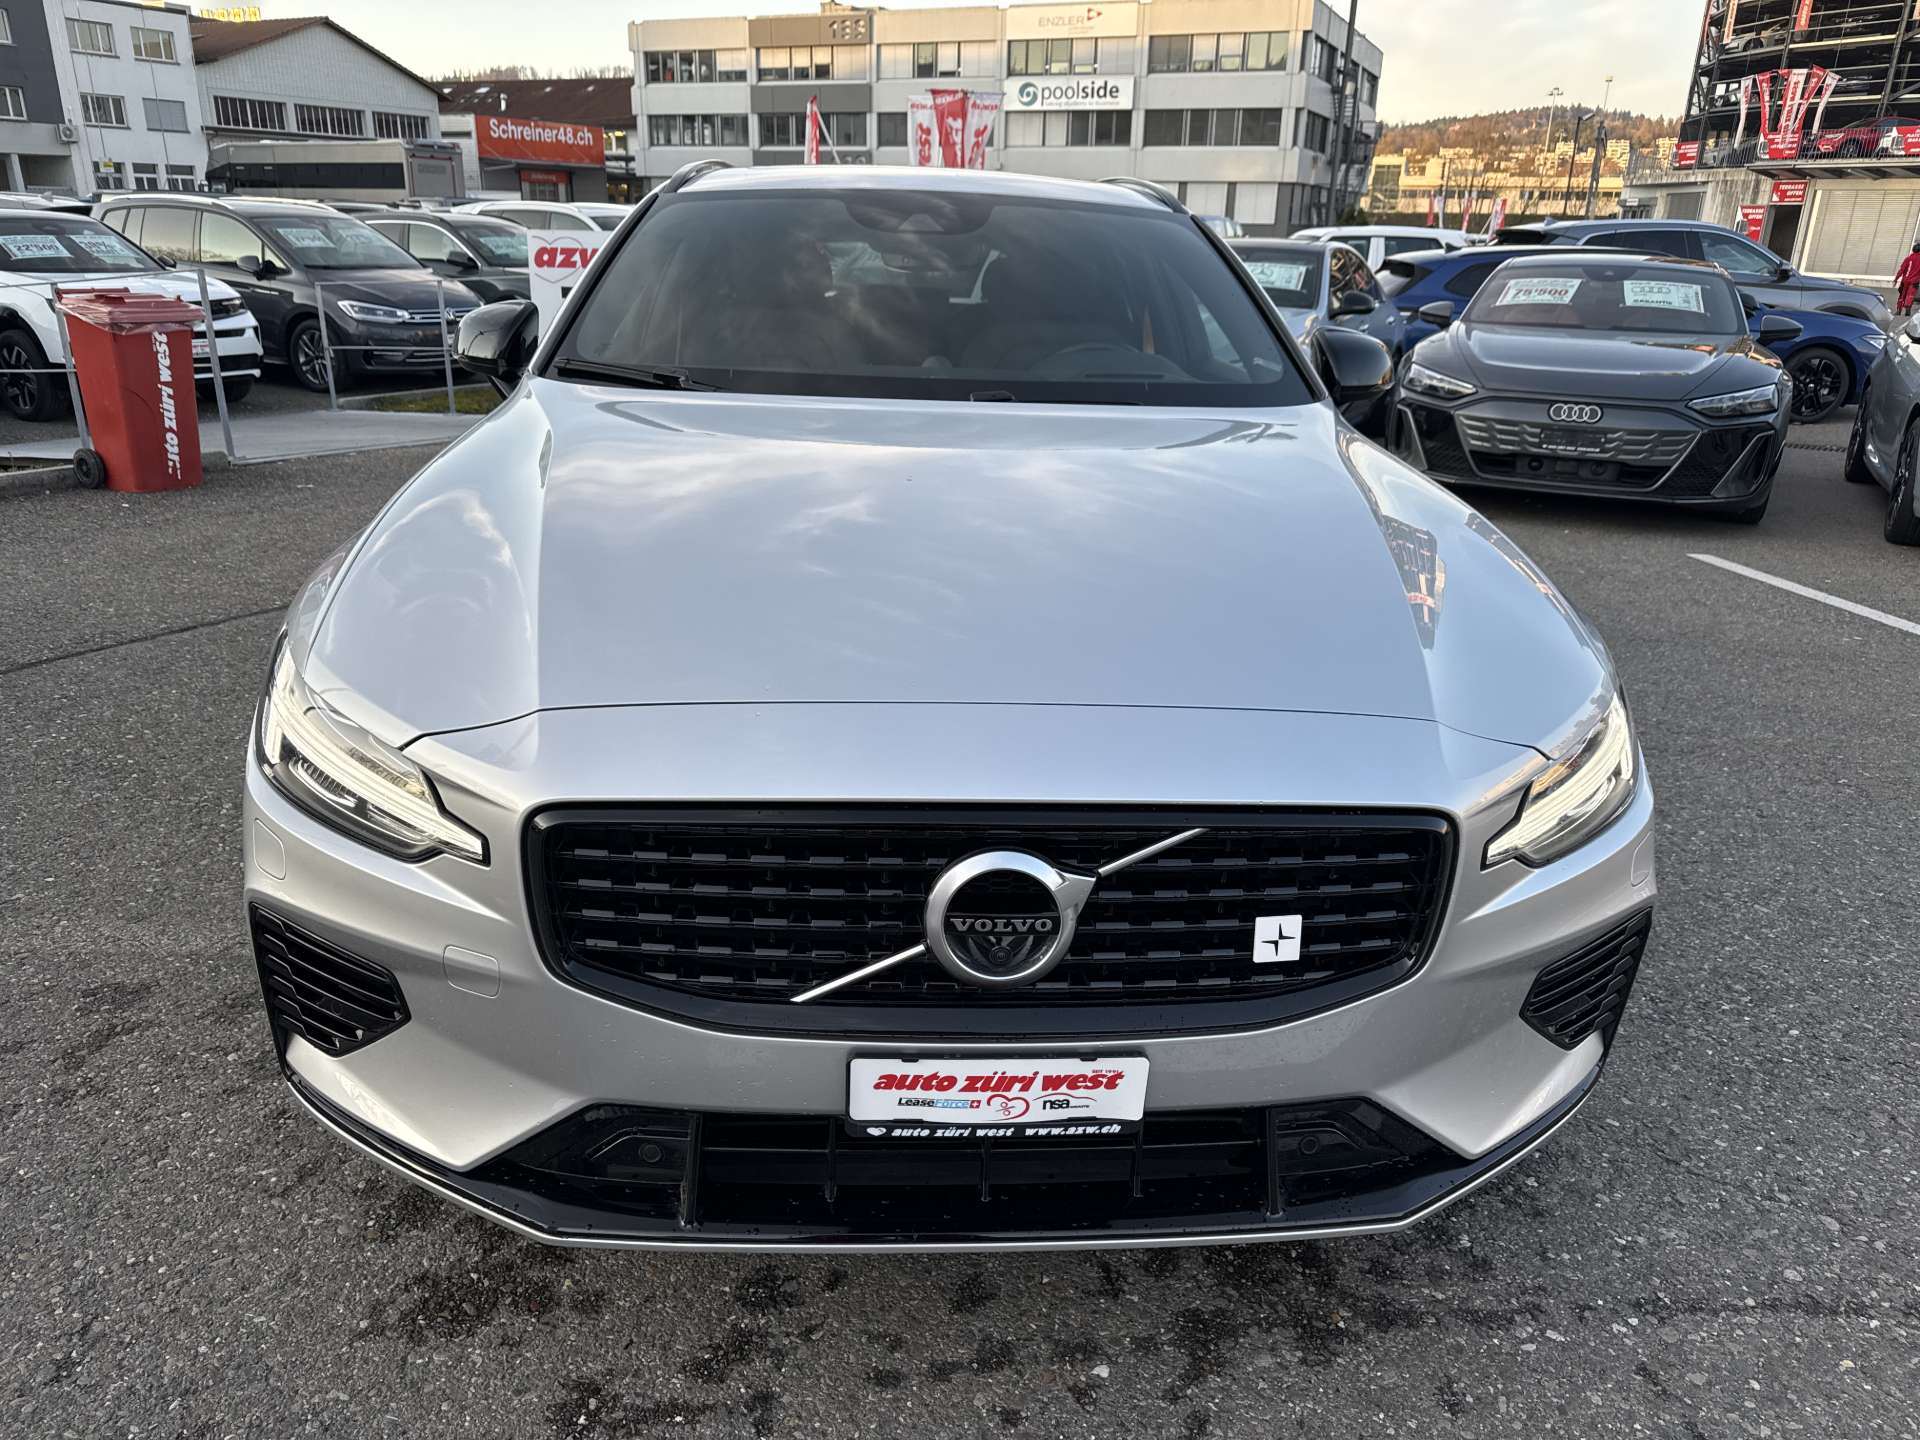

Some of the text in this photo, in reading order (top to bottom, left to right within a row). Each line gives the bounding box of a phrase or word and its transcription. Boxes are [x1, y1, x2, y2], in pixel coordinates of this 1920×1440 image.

[1038, 15, 1085, 27] ENZLER
[1041, 80, 1120, 106] poolside
[489, 117, 593, 146] Schreiner48.ch
[156, 330, 173, 382] west
[157, 383, 177, 432] züri
[950, 918, 1053, 932] VOLVO
[873, 1071, 1125, 1092] auto züri west
[897, 1097, 969, 1109] LeaseForce
[1042, 1098, 1070, 1110] nsa
[891, 1124, 1122, 1137] auto züri west www.azw.ch
